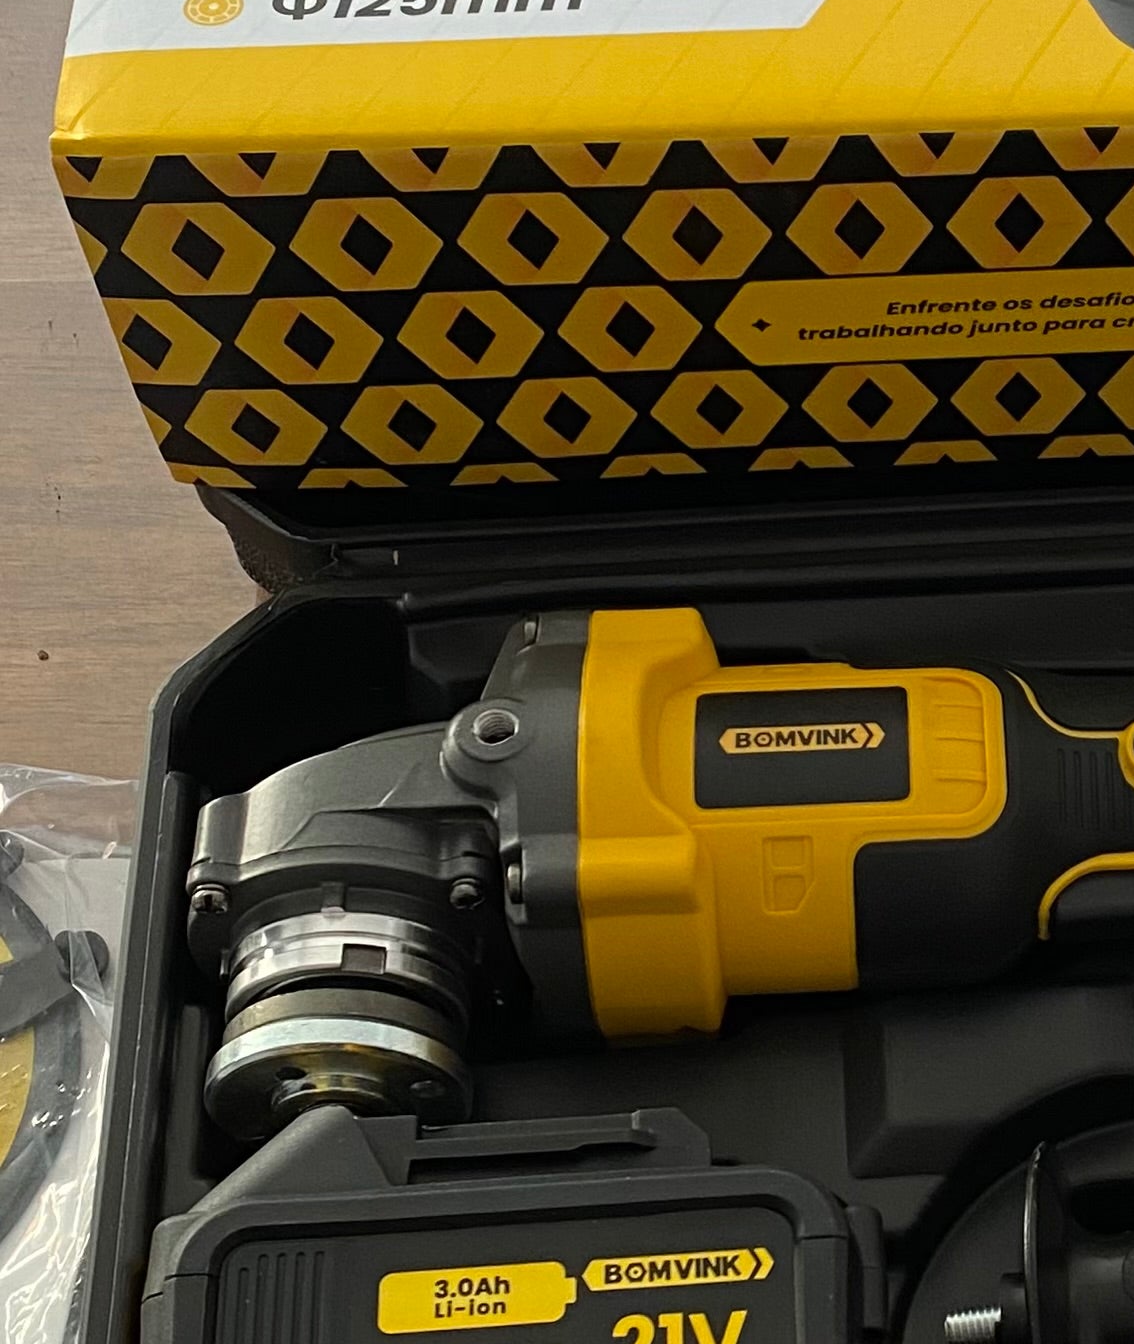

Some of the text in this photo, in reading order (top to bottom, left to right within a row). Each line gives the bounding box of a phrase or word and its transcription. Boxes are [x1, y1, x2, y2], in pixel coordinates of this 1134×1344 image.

[886, 299, 997, 316] Enfrente
[1002, 297, 1034, 311] os
[798, 322, 964, 341] trabalhando
[966, 319, 1037, 338] junto
[1042, 317, 1104, 335] para
[735, 728, 859, 748] BOMVINK
[603, 1254, 743, 1285] BOMVINK
[434, 1277, 511, 1299] 3.0Ah
[434, 1299, 507, 1319] Li-ion
